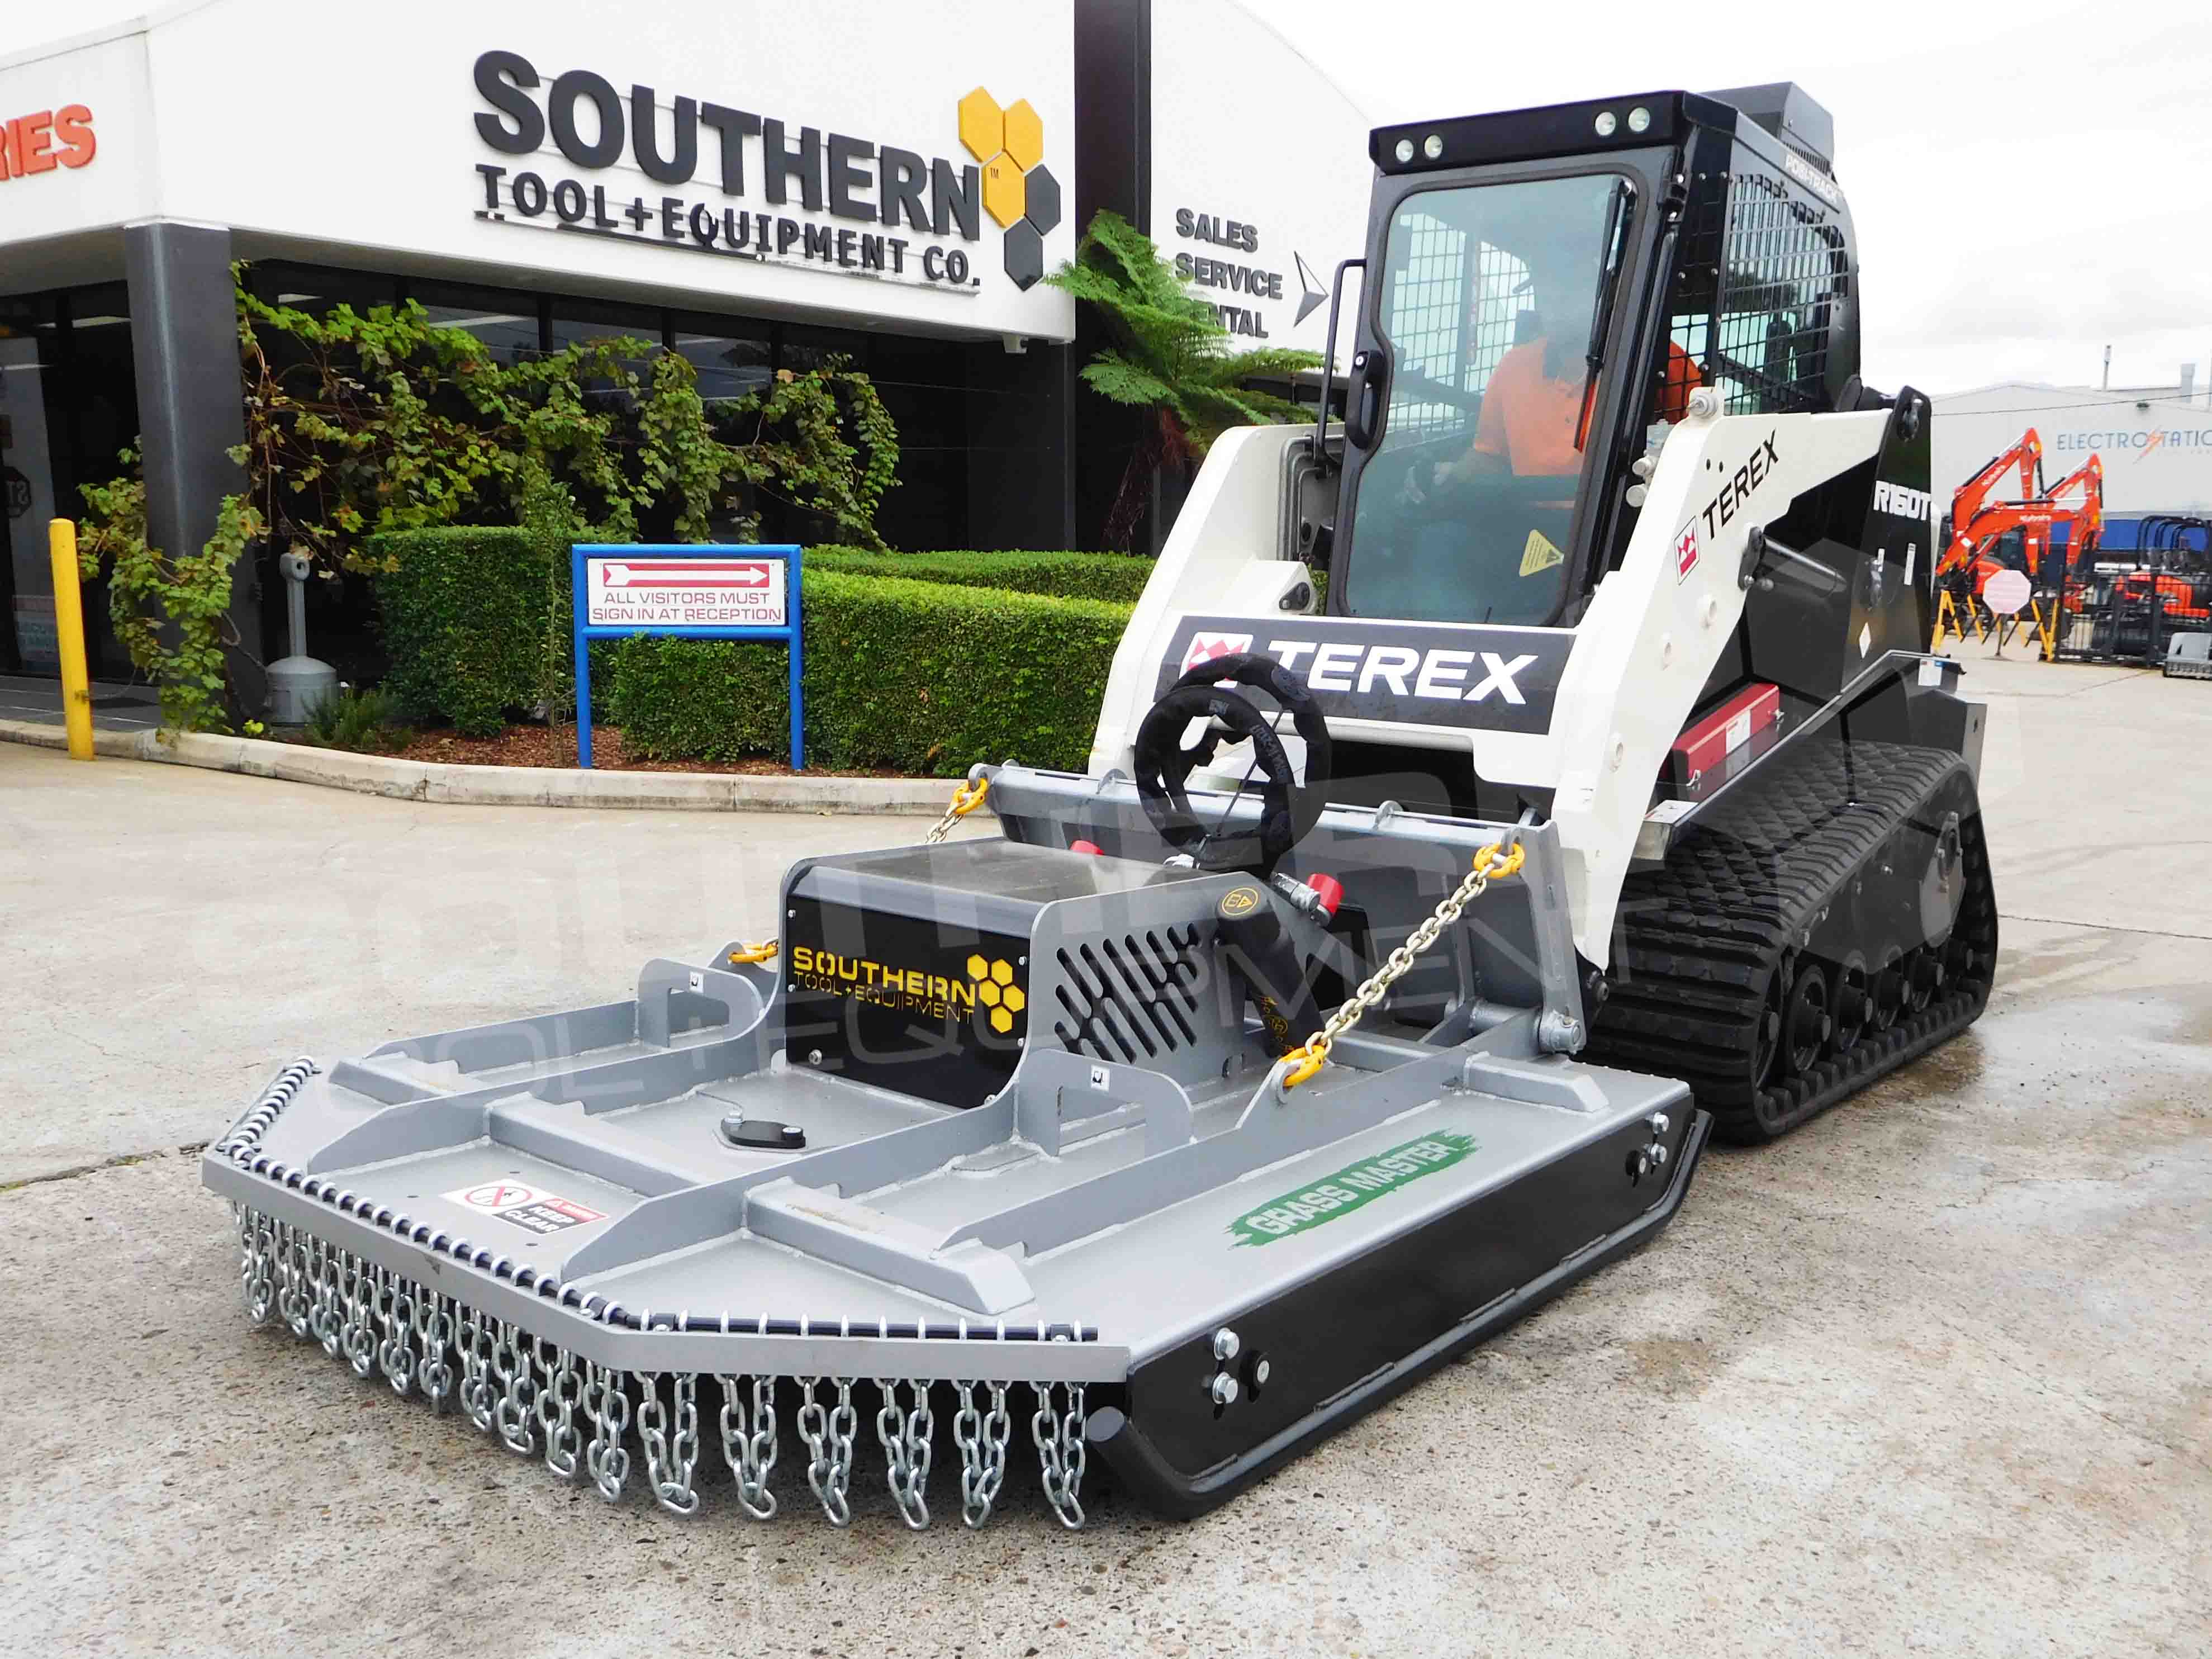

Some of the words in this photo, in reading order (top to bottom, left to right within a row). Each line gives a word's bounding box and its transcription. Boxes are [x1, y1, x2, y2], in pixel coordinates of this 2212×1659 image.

[473, 50, 980, 241] SOUTHERN
[990, 167, 999, 179] TM
[476, 163, 909, 273] TOOL+EQUIPMENT
[923, 245, 980, 287] CO.
[1176, 208, 1258, 253] SALES
[1176, 252, 1283, 300] SERVICE
[1198, 299, 1269, 339] NTAL
[1702, 428, 1779, 542] TEREX
[592, 608, 633, 620] SIGN
[637, 608, 654, 620] IN
[658, 608, 680, 620] AT
[684, 608, 781, 620] RECEPTION
[604, 592, 635, 604] ALL
[639, 592, 716, 604] VISITORS
[720, 592, 770, 604] MUST
[1267, 639, 1538, 705] TEREX
[792, 946, 975, 1007] SOUTHERN
[1245, 1184, 1360, 1235] GRASS
[1340, 1139, 1456, 1192] MASTER
[505, 1210, 559, 1232] CLEAR
[528, 1205, 576, 1223] KEEP
